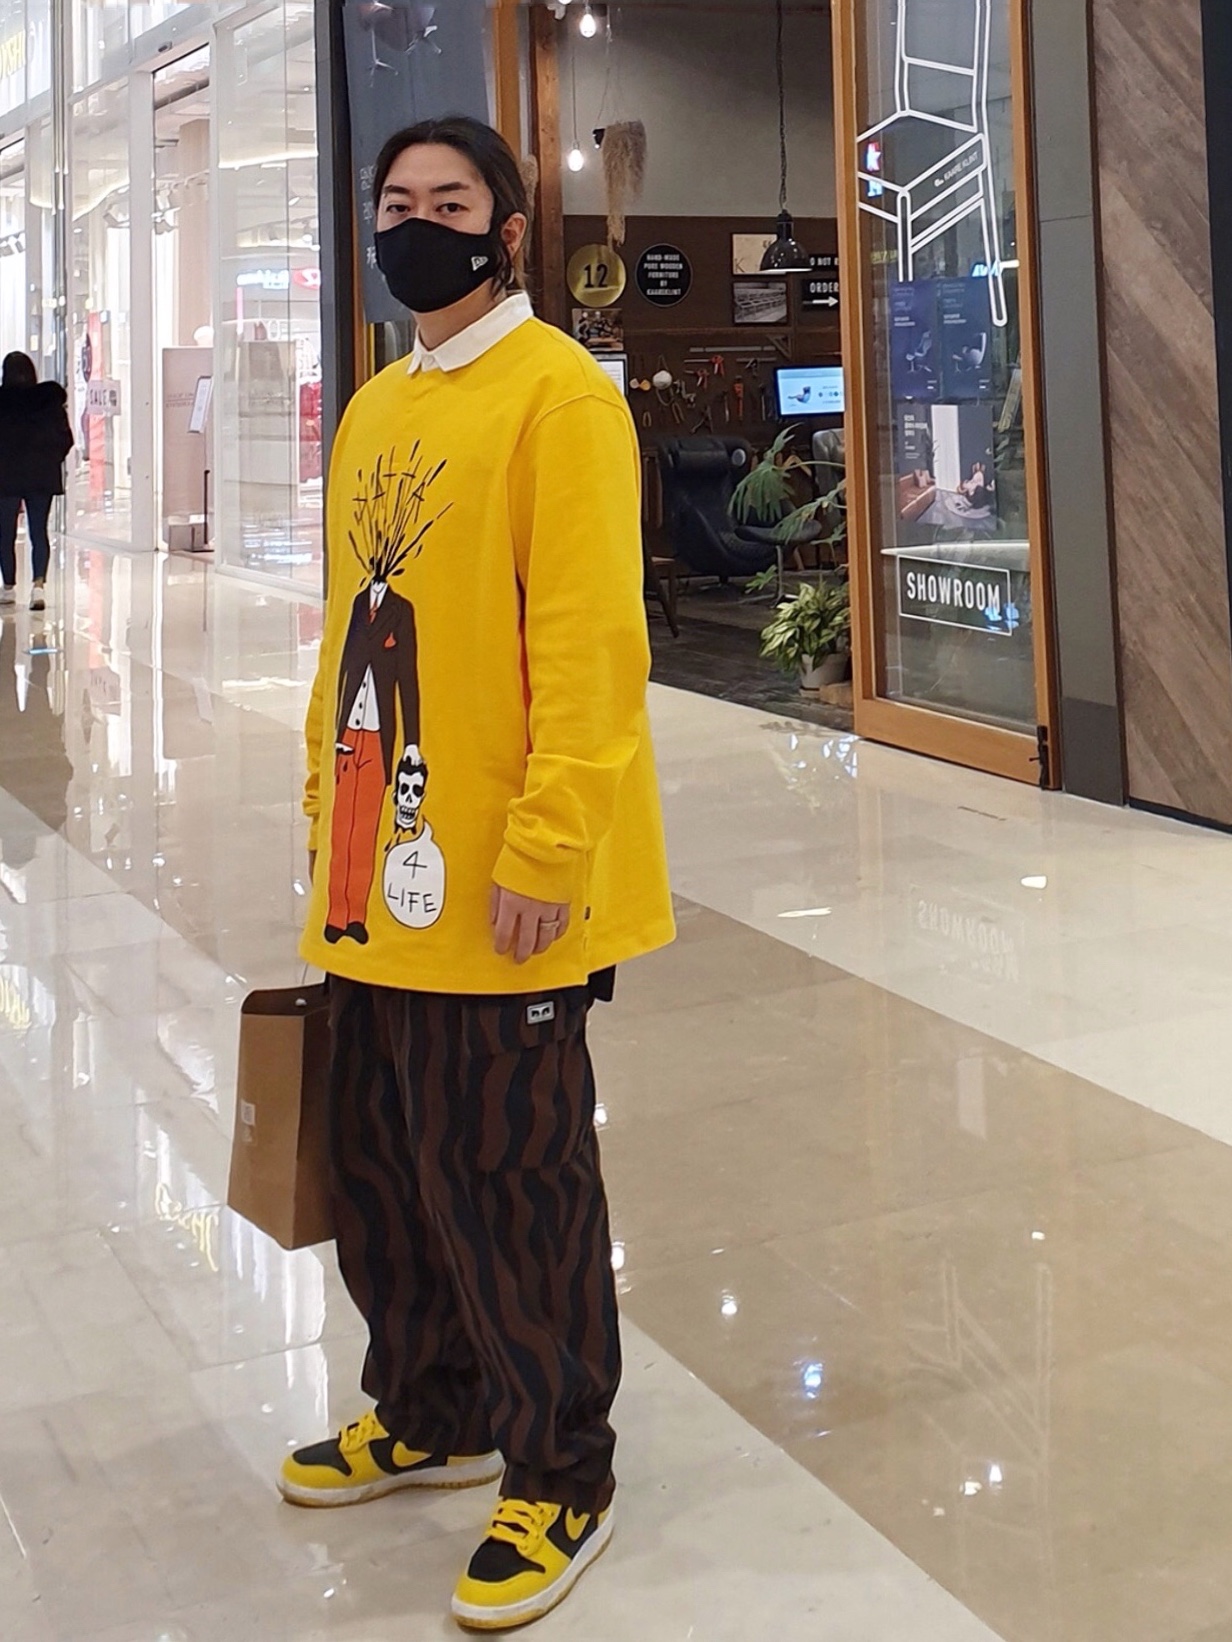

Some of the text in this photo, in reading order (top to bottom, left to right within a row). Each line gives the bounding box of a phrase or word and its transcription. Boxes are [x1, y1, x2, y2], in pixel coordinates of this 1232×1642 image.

[584, 263, 609, 288] 12
[809, 282, 840, 293] ORDER
[906, 571, 1001, 613] SHOWROOM
[402, 850, 428, 879] 4
[387, 882, 437, 913] LIFE
